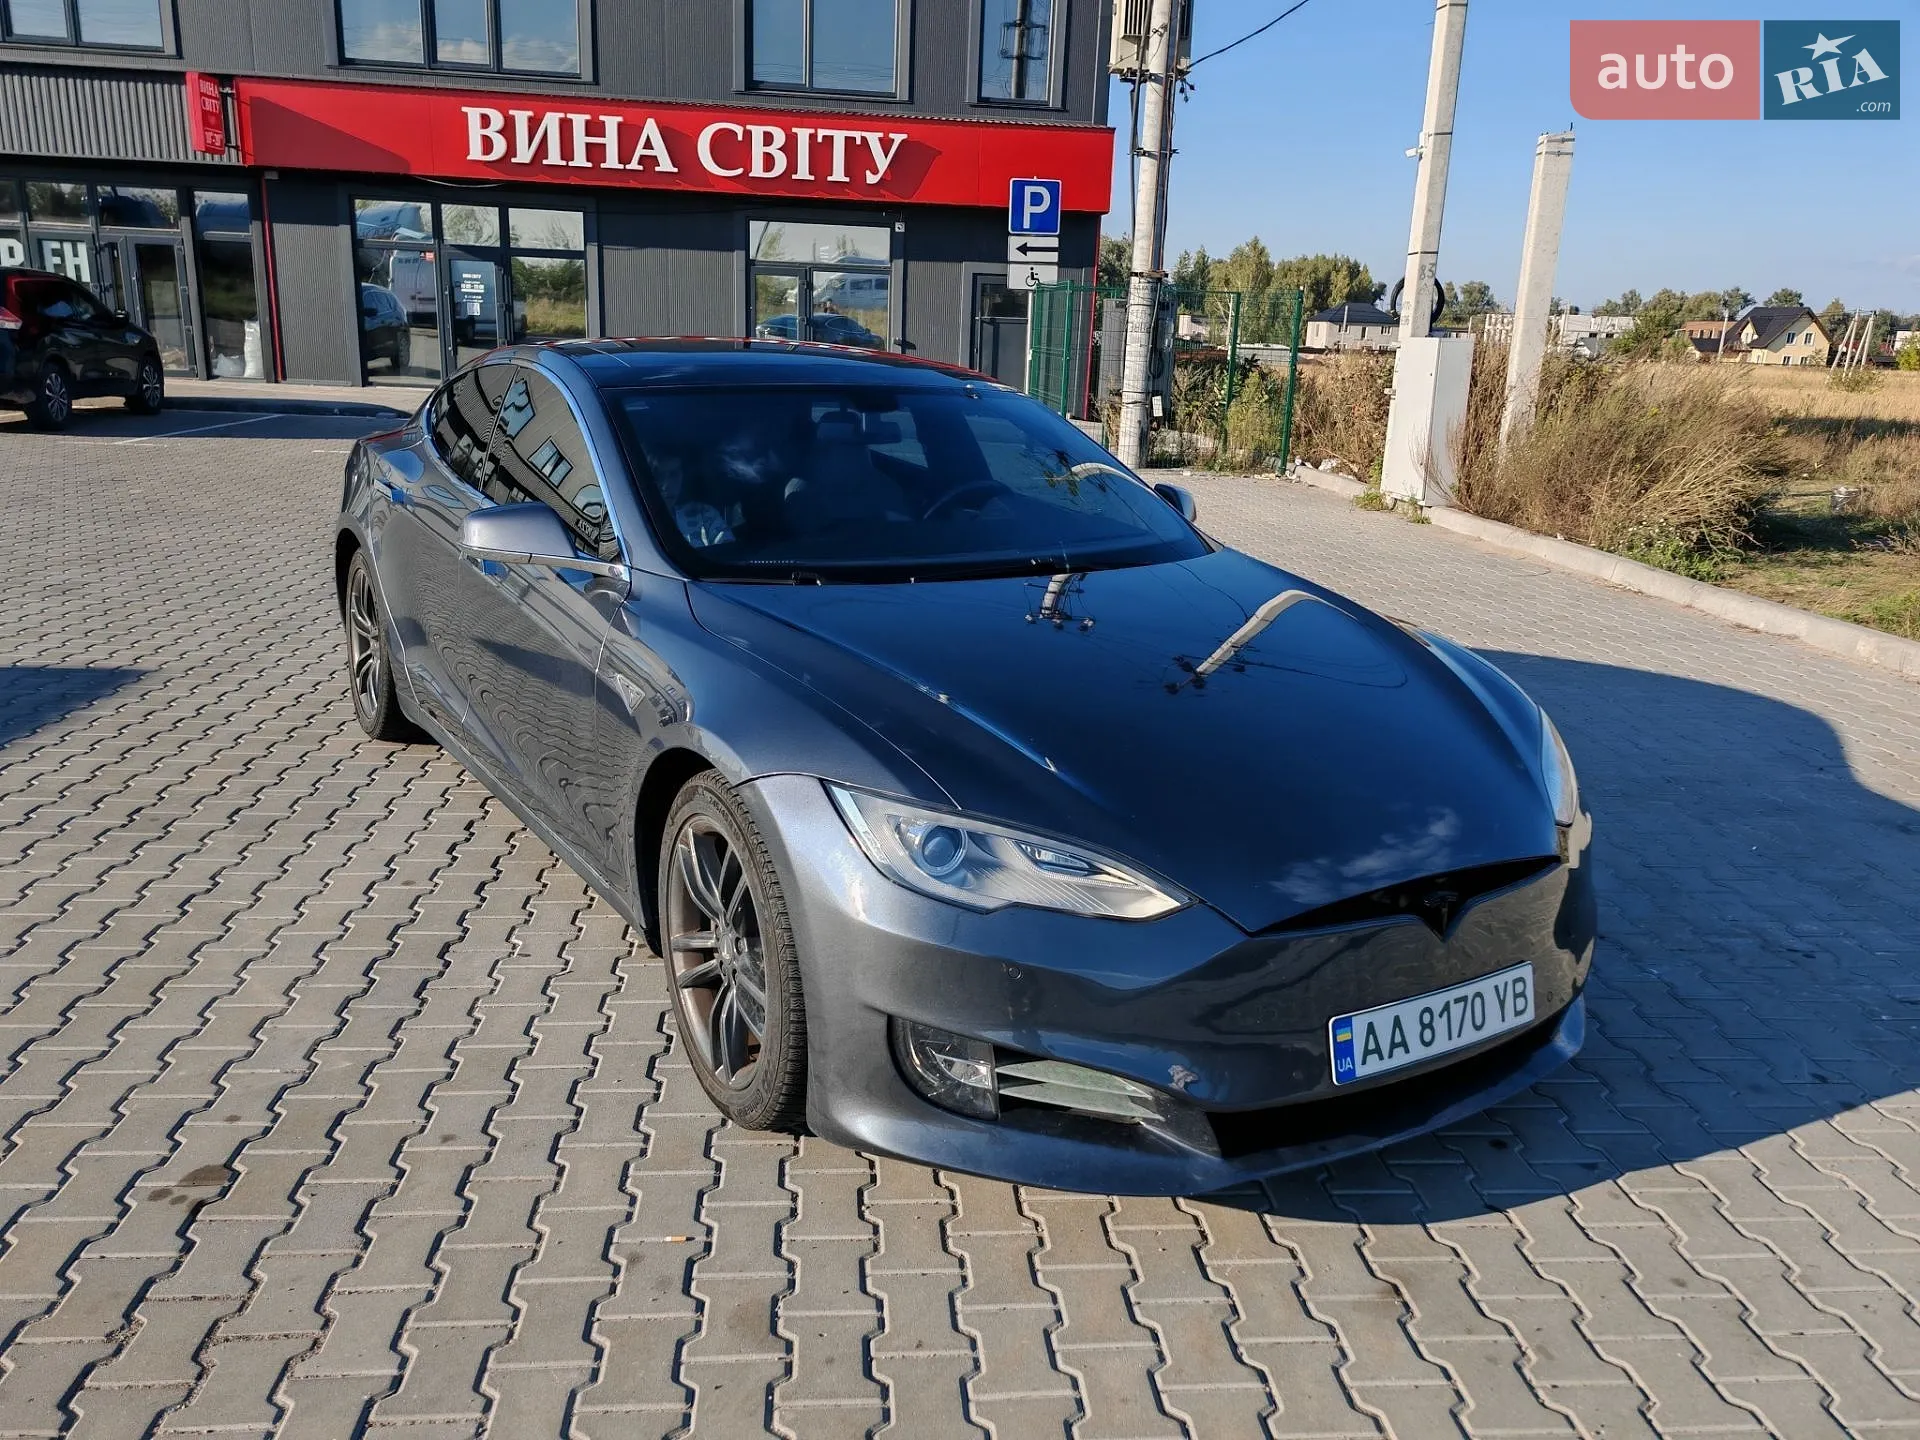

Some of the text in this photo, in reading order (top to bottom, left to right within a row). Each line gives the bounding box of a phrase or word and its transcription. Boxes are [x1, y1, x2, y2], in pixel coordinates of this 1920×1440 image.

[461, 106, 908, 184] ВИНА СВІТУ
[1023, 186, 1051, 229] P
[1361, 976, 1529, 1066] AA 8170 YB
[1337, 1056, 1353, 1072] UA
